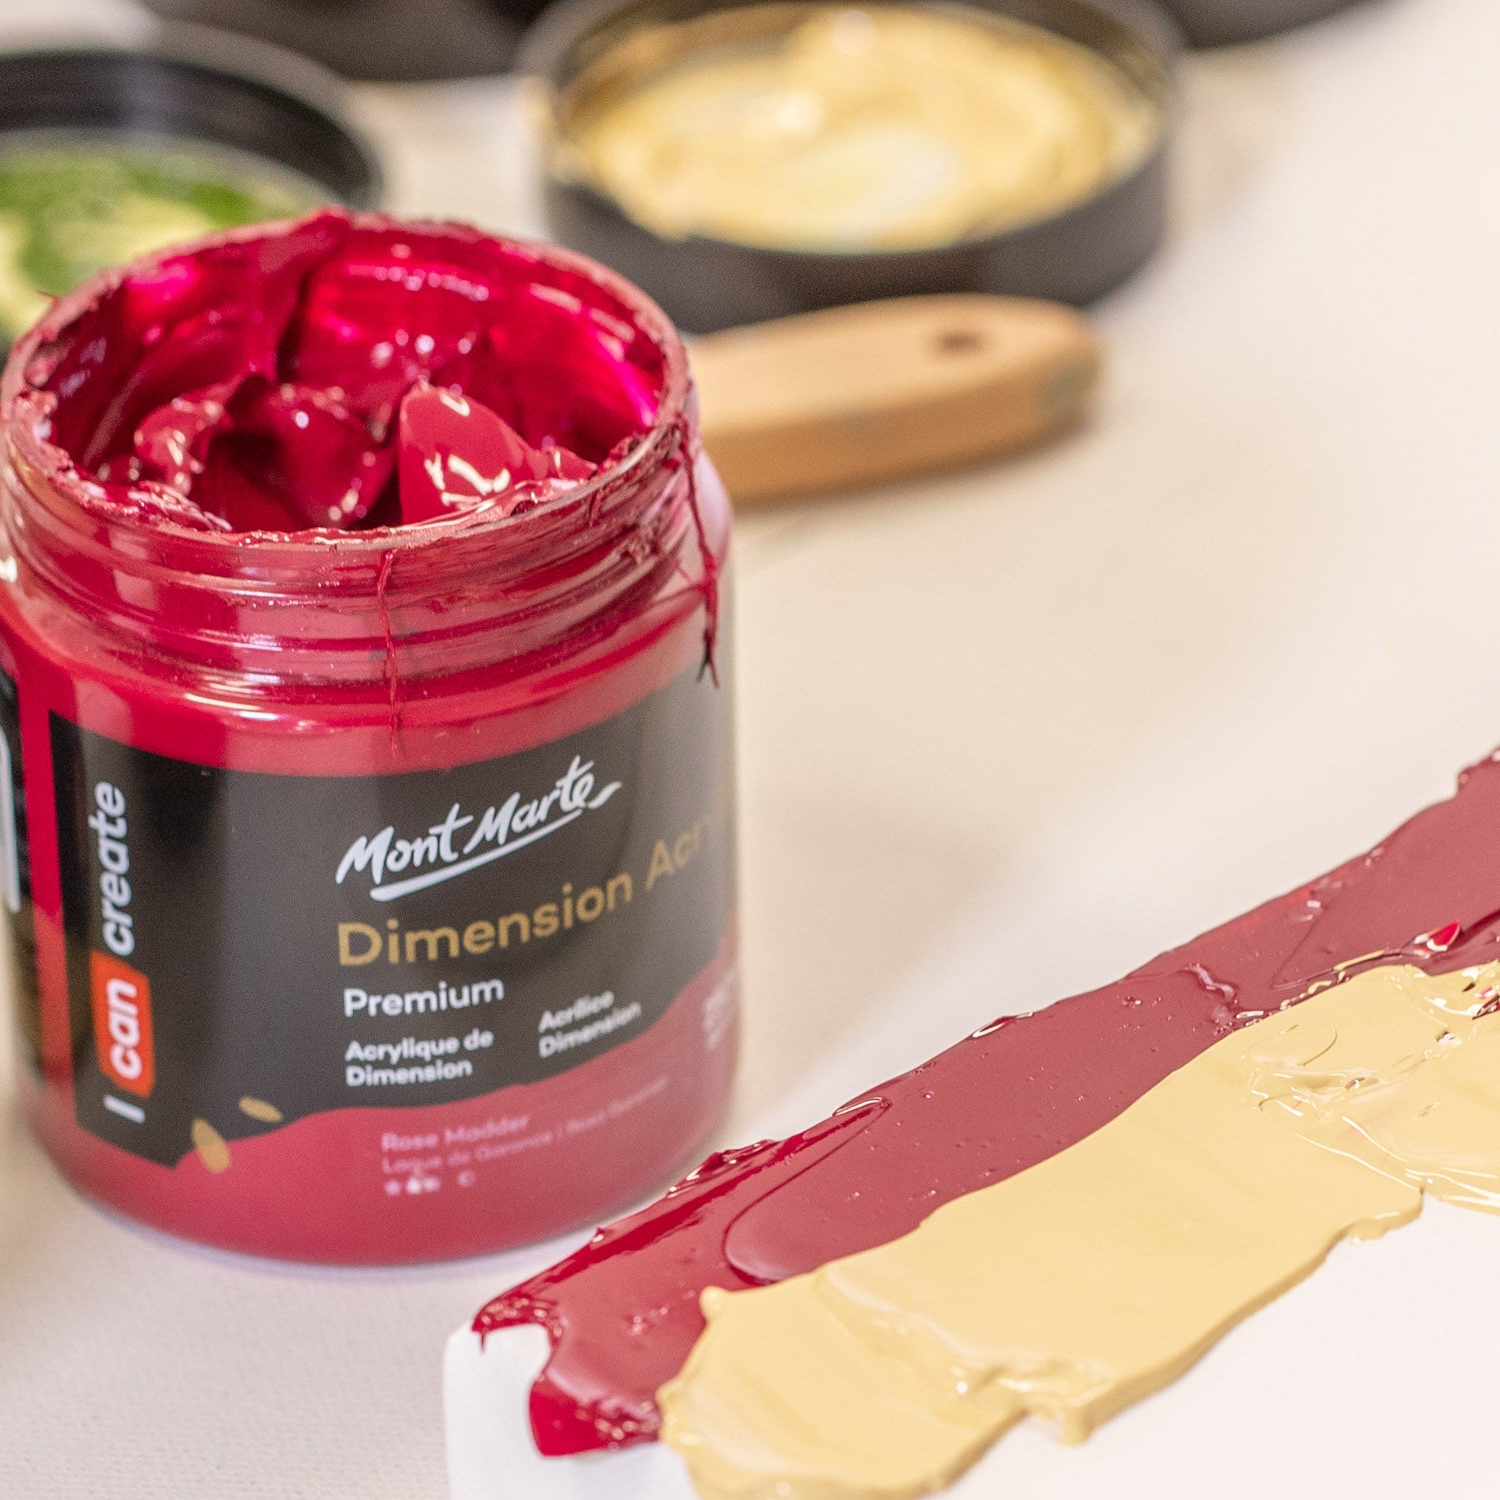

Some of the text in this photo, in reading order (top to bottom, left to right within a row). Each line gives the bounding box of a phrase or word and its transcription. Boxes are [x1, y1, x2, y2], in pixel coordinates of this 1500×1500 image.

[335, 754, 622, 885] Mont Marte
[337, 871, 634, 967] Dimension
[88, 780, 146, 1125] I can create
[343, 977, 505, 1018] Premium
[345, 1028, 495, 1066] Acrylique de
[345, 1058, 474, 1087] Dimension
[380, 1114, 530, 1152] Rose Madder
[381, 1155, 443, 1175] Laque
